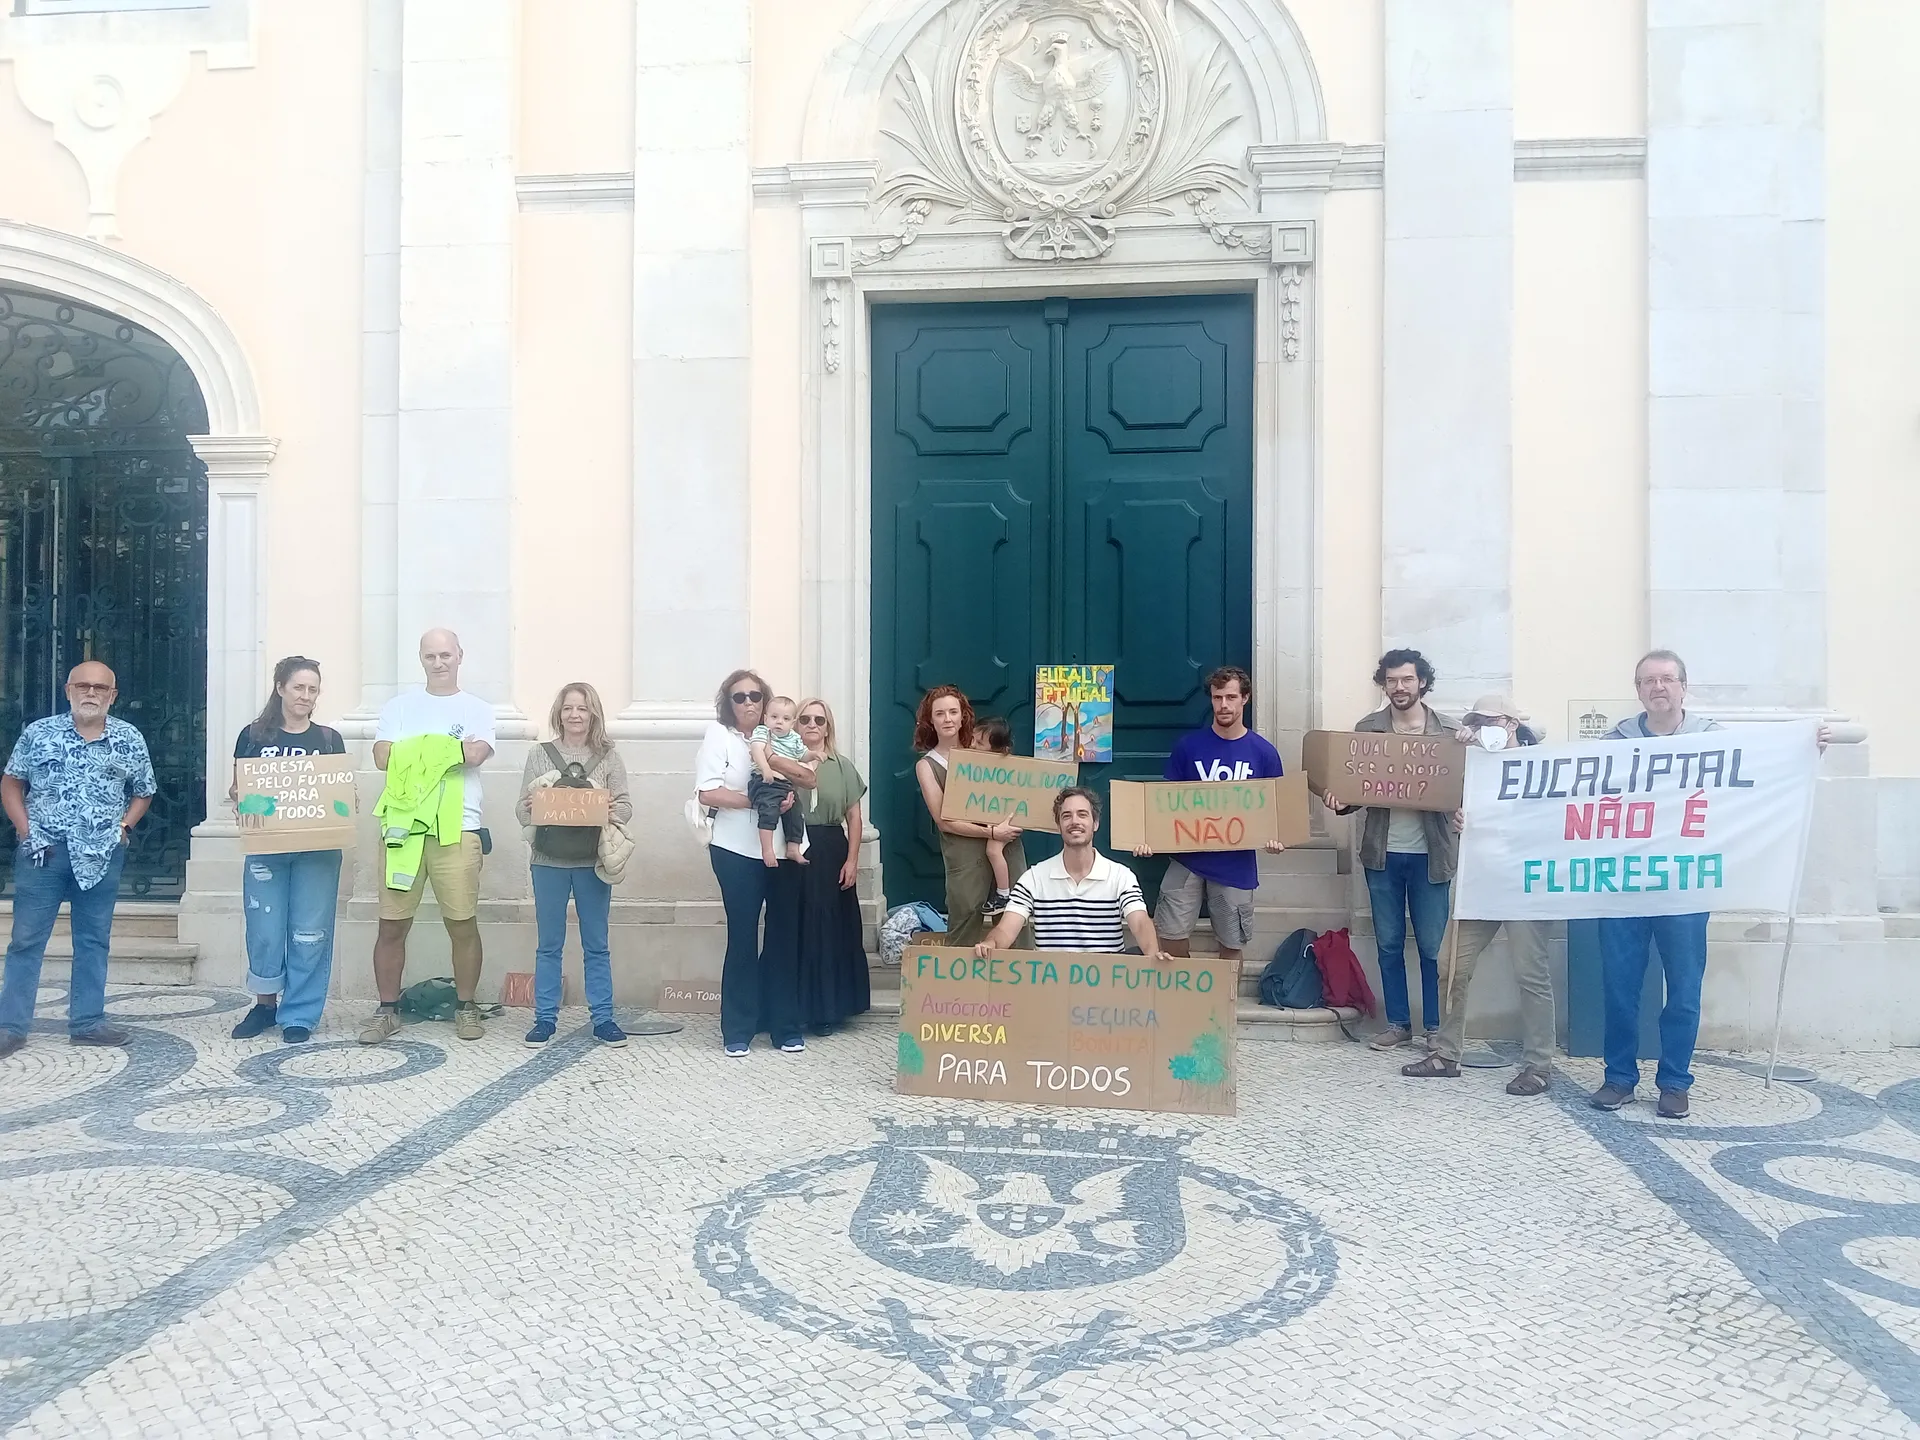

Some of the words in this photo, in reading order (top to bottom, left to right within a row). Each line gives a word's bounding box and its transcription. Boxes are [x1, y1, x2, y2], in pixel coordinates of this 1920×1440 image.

[1349, 738, 1391, 761] QUAL
[1402, 740, 1441, 758] DEVE
[244, 760, 315, 775] FLORESTA
[298, 771, 354, 786] FUTURO
[955, 761, 1076, 789] MONOCULTURA
[1194, 758, 1253, 782] Volt
[275, 804, 327, 820] TODOS
[965, 791, 1029, 817] MATA
[1564, 795, 1656, 841] NÃO
[1680, 788, 1709, 838] É
[1173, 816, 1245, 846] NÃO
[1524, 853, 1723, 894] FLORESTA
[917, 954, 1059, 985] FLORESTA
[1069, 964, 1101, 988] DO
[1112, 964, 1214, 993] FUTURO
[664, 986, 693, 1000] PARA
[1071, 1006, 1160, 1034] SEGURA
[920, 1022, 1008, 1046] DIVERSA
[937, 1053, 1008, 1087] PARA
[1026, 1060, 1133, 1097] TODOS
